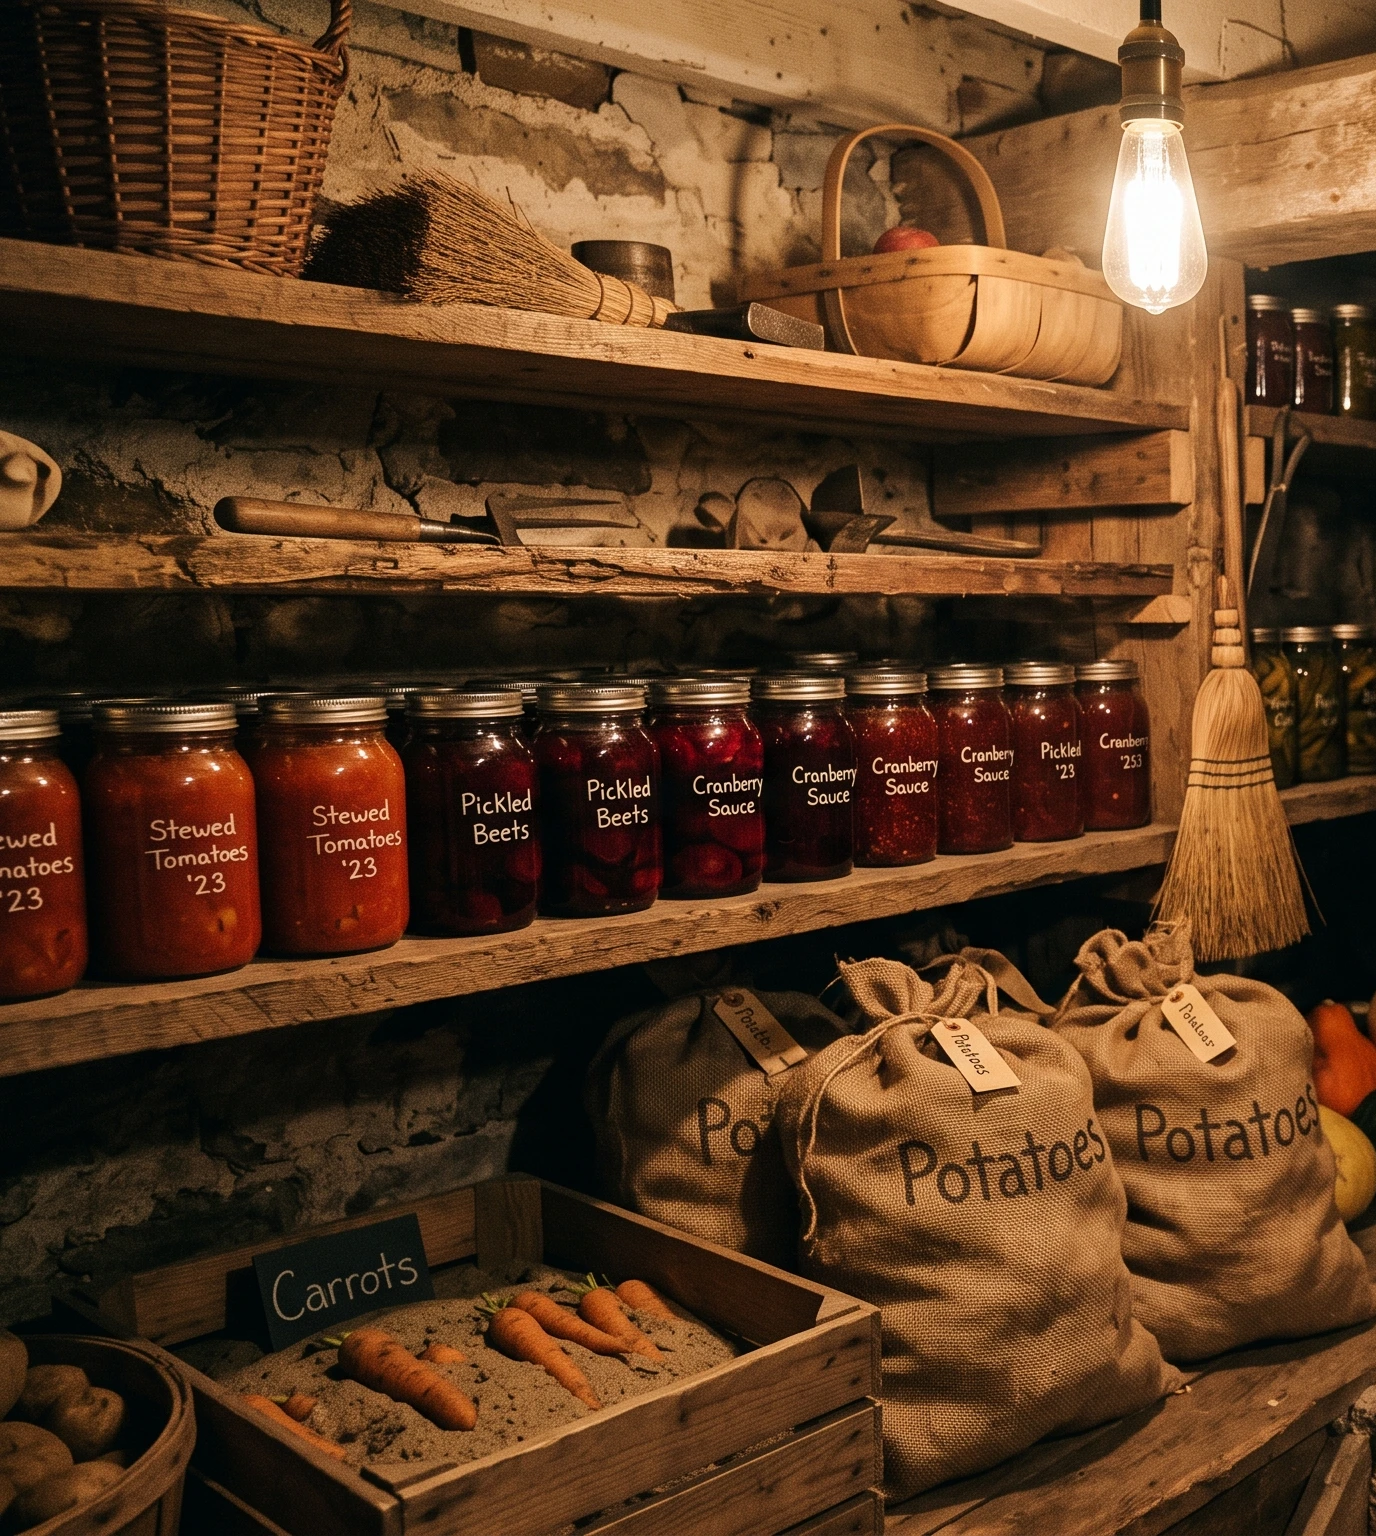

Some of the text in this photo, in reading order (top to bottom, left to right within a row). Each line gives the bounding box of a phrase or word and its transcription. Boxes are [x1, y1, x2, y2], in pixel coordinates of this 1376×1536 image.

[1041, 740, 1081, 760] Pickled
[792, 764, 858, 787] Cranberry
[872, 756, 938, 778] Cranberry
[974, 767, 1010, 783] Sauce
[1056, 765, 1075, 780] '23
[587, 776, 651, 801] Pickled
[693, 775, 763, 797] Cranberry
[807, 789, 850, 805] Sauce
[885, 778, 930, 796] Sauce
[312, 799, 390, 826] Stewed
[462, 789, 532, 815] Pickled
[708, 800, 756, 817] Sauce
[150, 813, 236, 841] Stewed
[597, 806, 649, 828] Beets
[307, 829, 401, 856] Tomatoes
[474, 824, 529, 845] Beets
[145, 844, 248, 871] Tomatoes
[342, 857, 377, 880] '23
[187, 872, 226, 895] '23
[1135, 1083, 1319, 1163] Potatoes
[898, 1119, 1105, 1206] Potatoes
[272, 1252, 418, 1321] Carrots
